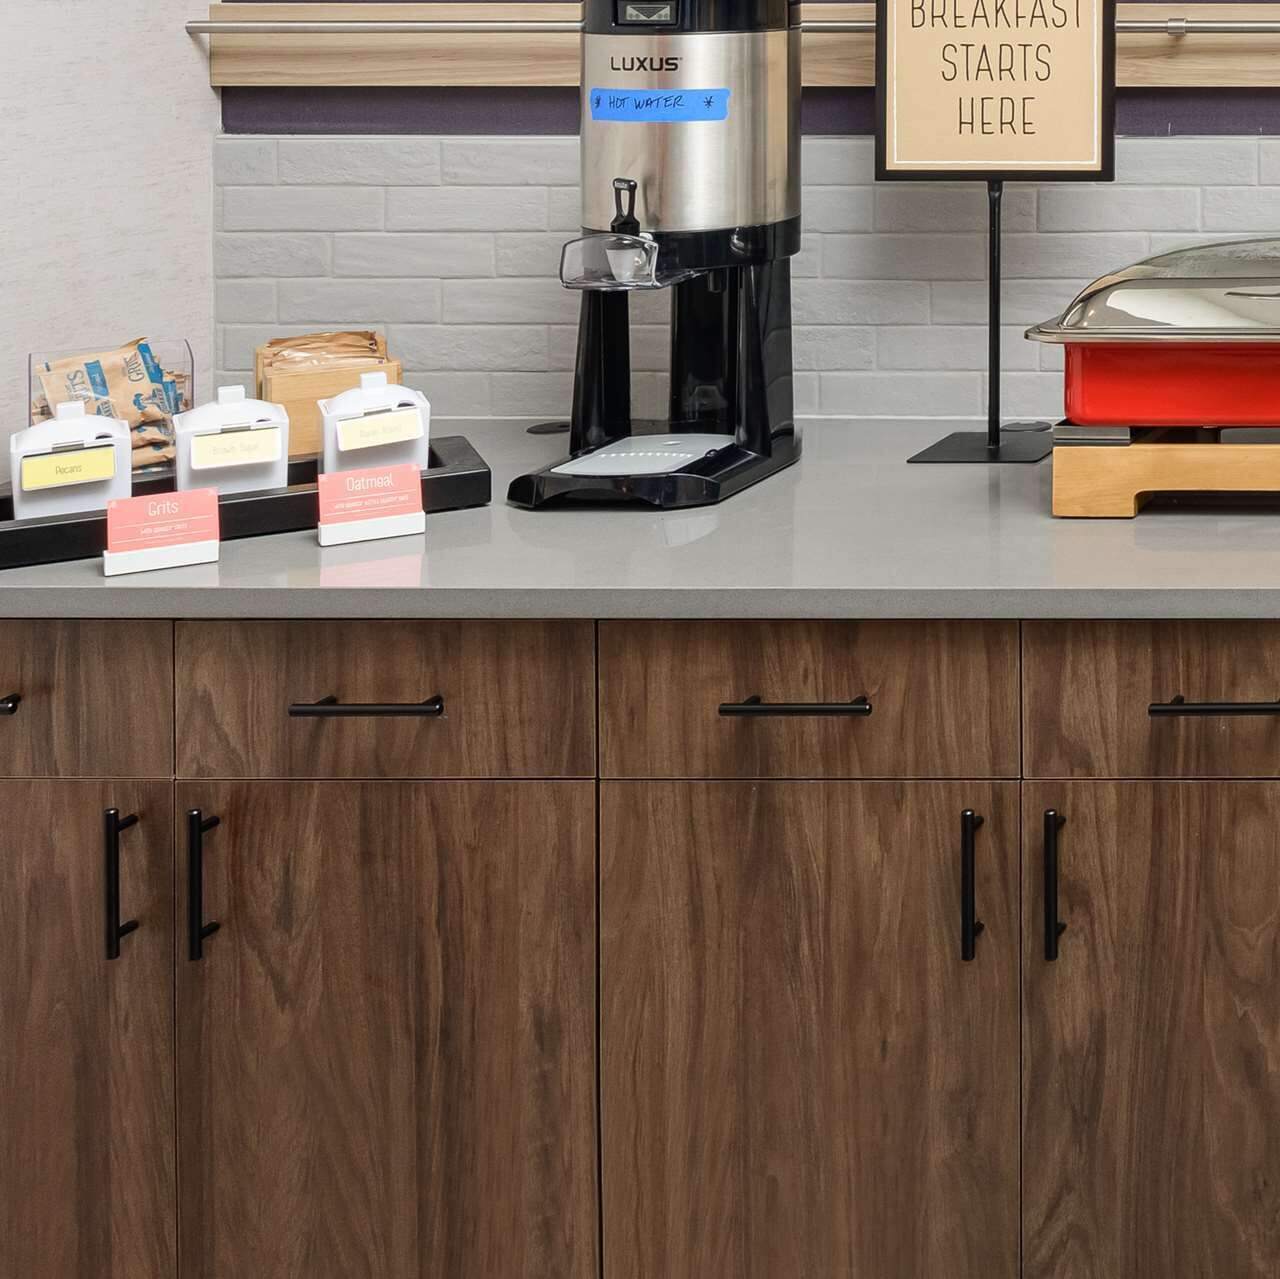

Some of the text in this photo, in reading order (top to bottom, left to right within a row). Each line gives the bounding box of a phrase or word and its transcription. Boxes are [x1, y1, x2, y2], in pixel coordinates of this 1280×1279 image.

[610, 56, 680, 72] LUXUS
[941, 43, 1052, 83] STARTS
[608, 95, 685, 110] HOT WATER
[957, 96, 1037, 135] HERE
[346, 472, 394, 492] Oatmeal
[148, 499, 179, 517] Grits
